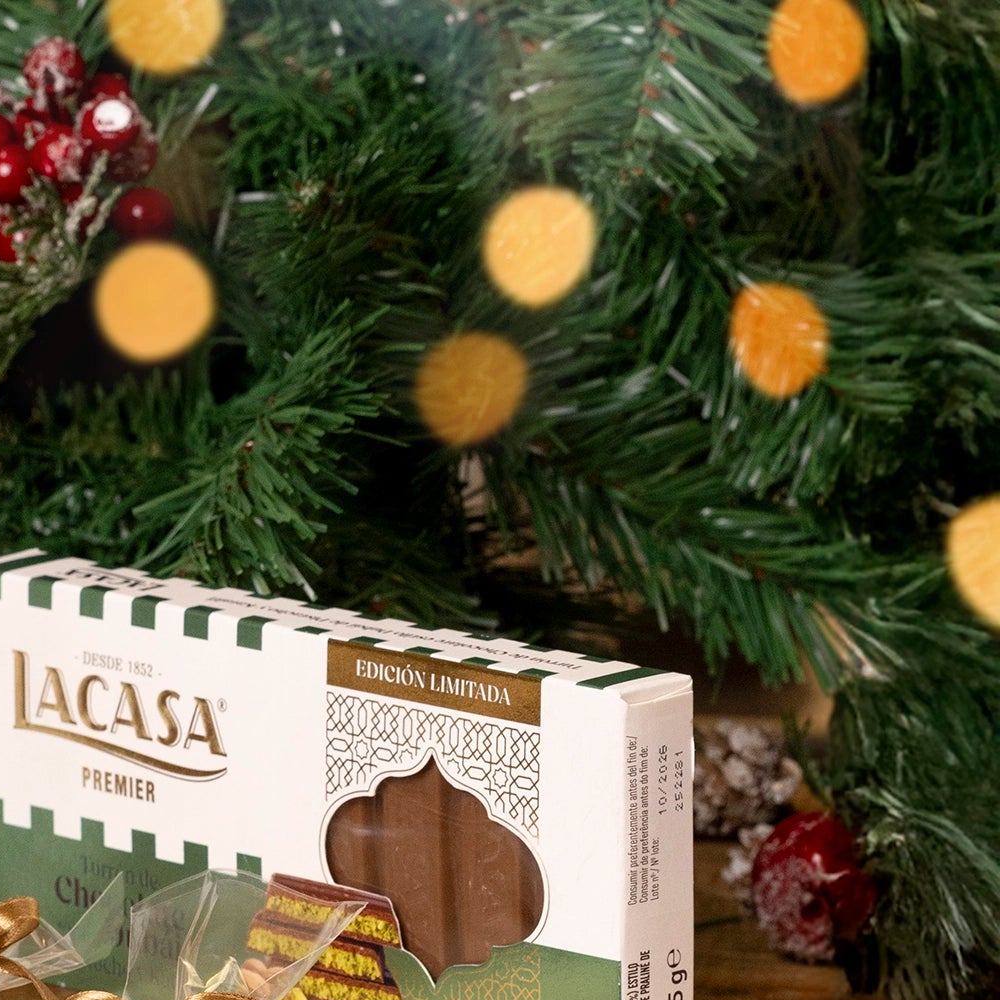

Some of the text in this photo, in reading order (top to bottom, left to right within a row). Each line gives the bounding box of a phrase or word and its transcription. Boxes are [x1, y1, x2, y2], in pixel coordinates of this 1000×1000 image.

[83, 651, 153, 678] DESDE 1852
[356, 659, 511, 706] EDICIÓN LIMITADA
[12, 649, 227, 758] LACASA
[626, 750, 637, 762] fin
[627, 762, 637, 776] del
[82, 766, 155, 803] PREMIER
[627, 777, 638, 801] antes
[658, 744, 668, 815] 10/2026
[674, 751, 684, 811] 252281
[628, 803, 639, 868] preferentemente
[639, 745, 650, 904] Consumir de preferência antes do fim de:
[650, 837, 660, 855] lote:
[628, 870, 638, 905] Consumir
[650, 883, 660, 901] Lote
[640, 950, 650, 961] DE
[628, 962, 639, 989] ESTILO
